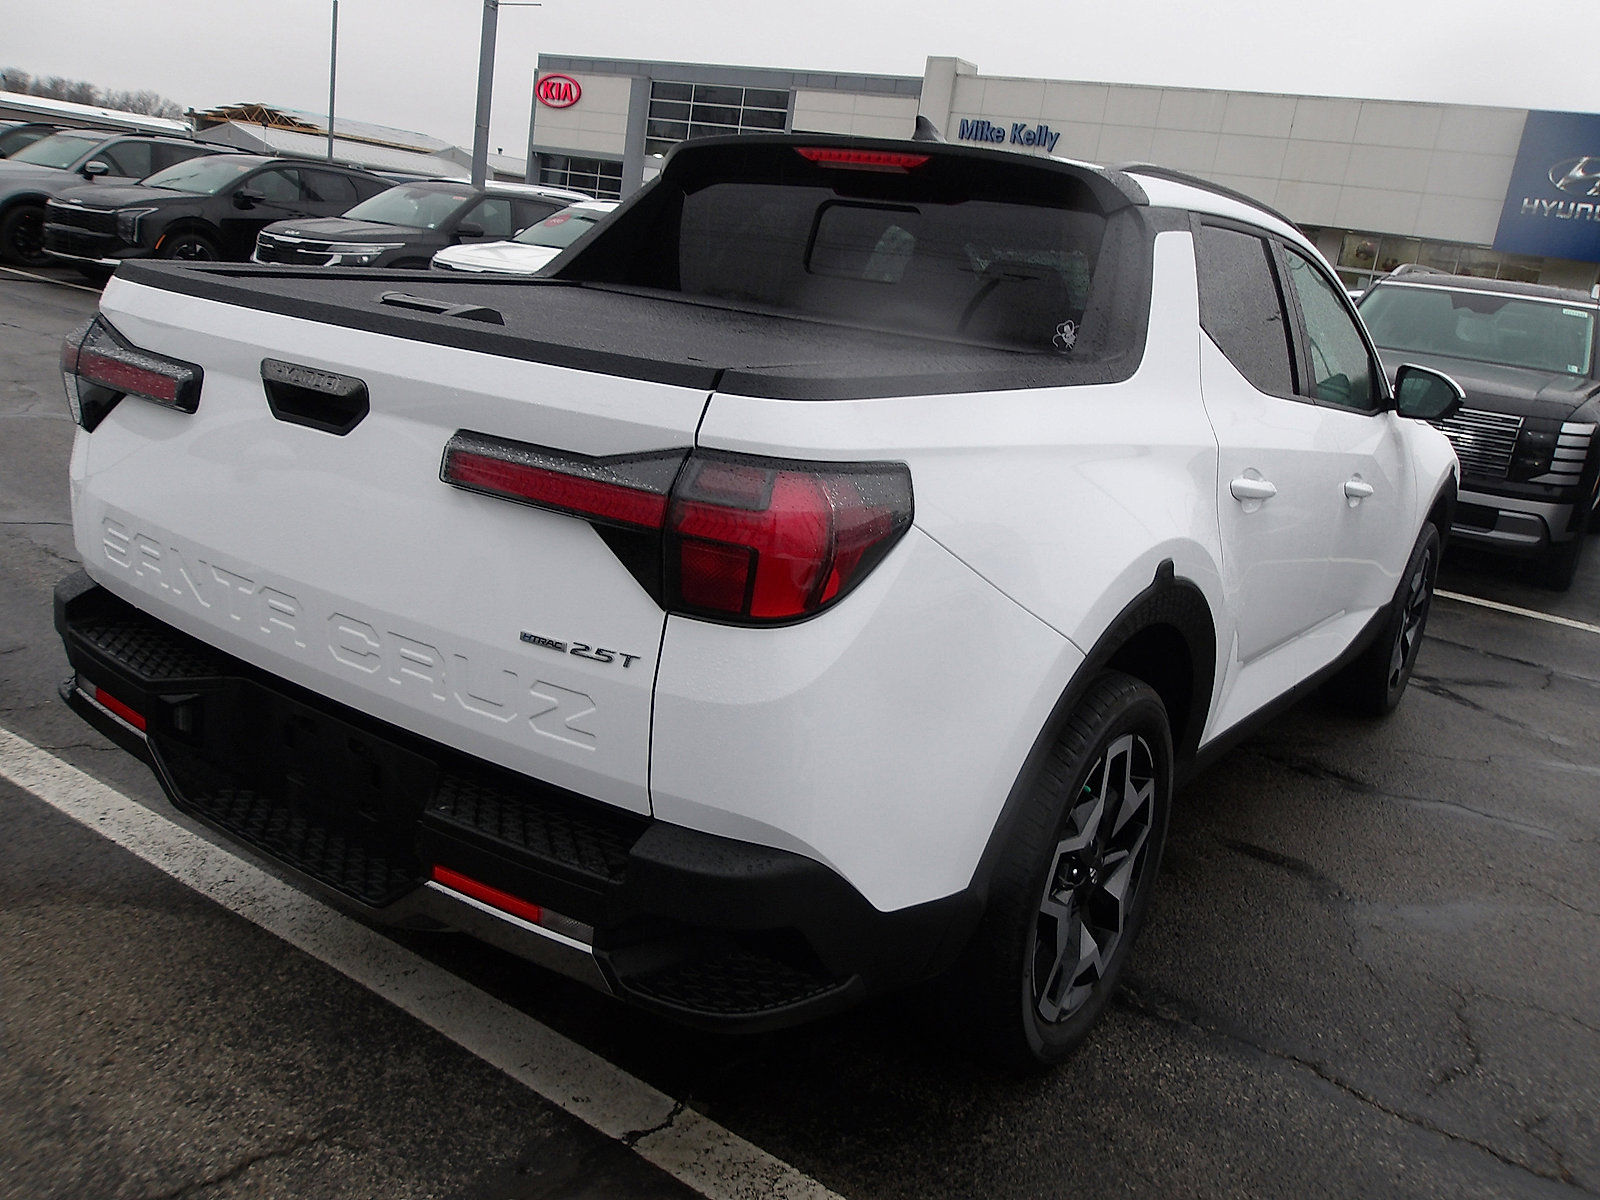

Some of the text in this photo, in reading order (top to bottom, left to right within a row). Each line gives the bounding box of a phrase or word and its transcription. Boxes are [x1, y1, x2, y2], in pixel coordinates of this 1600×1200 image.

[543, 80, 573, 102] KIA
[958, 118, 1061, 153] Mike Kelly
[101, 516, 597, 752] SANTA CRUZ
[521, 632, 564, 652] HTRAC
